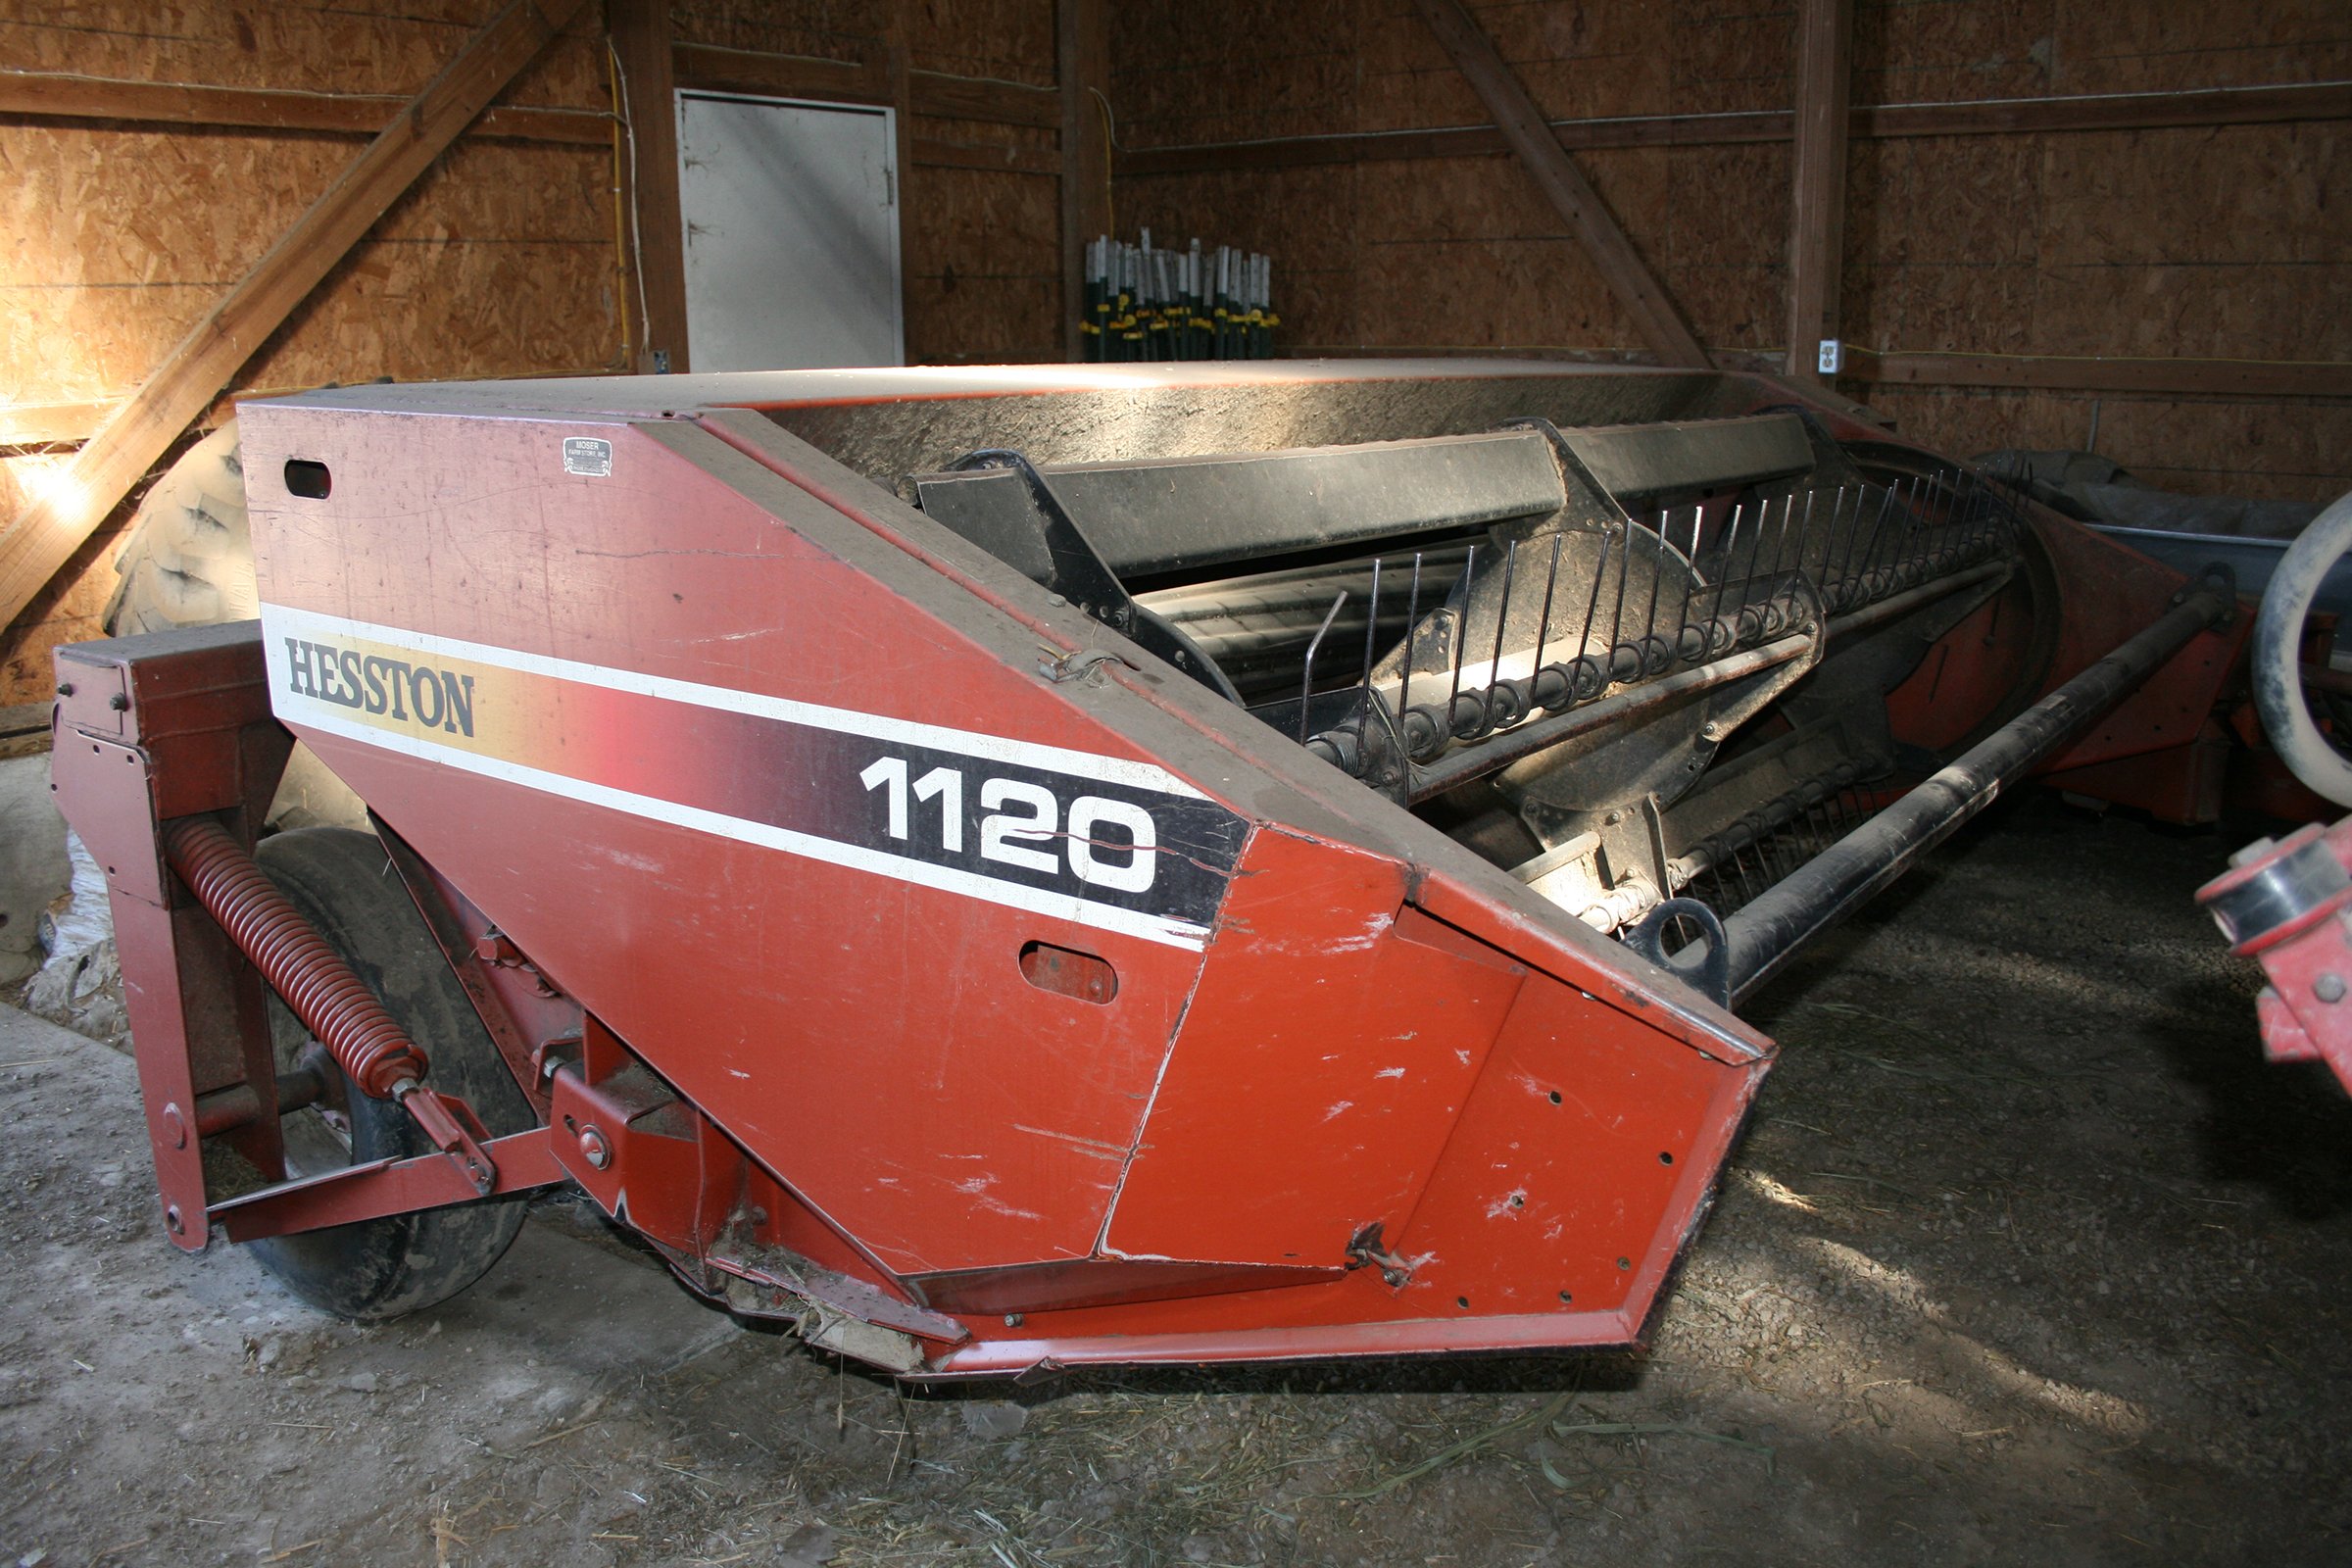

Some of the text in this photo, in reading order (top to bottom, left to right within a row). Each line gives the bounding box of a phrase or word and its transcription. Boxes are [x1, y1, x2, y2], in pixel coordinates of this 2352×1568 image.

[575, 441, 599, 450] MOSER
[284, 637, 475, 737] HESSTON
[859, 757, 1156, 893] 1120
